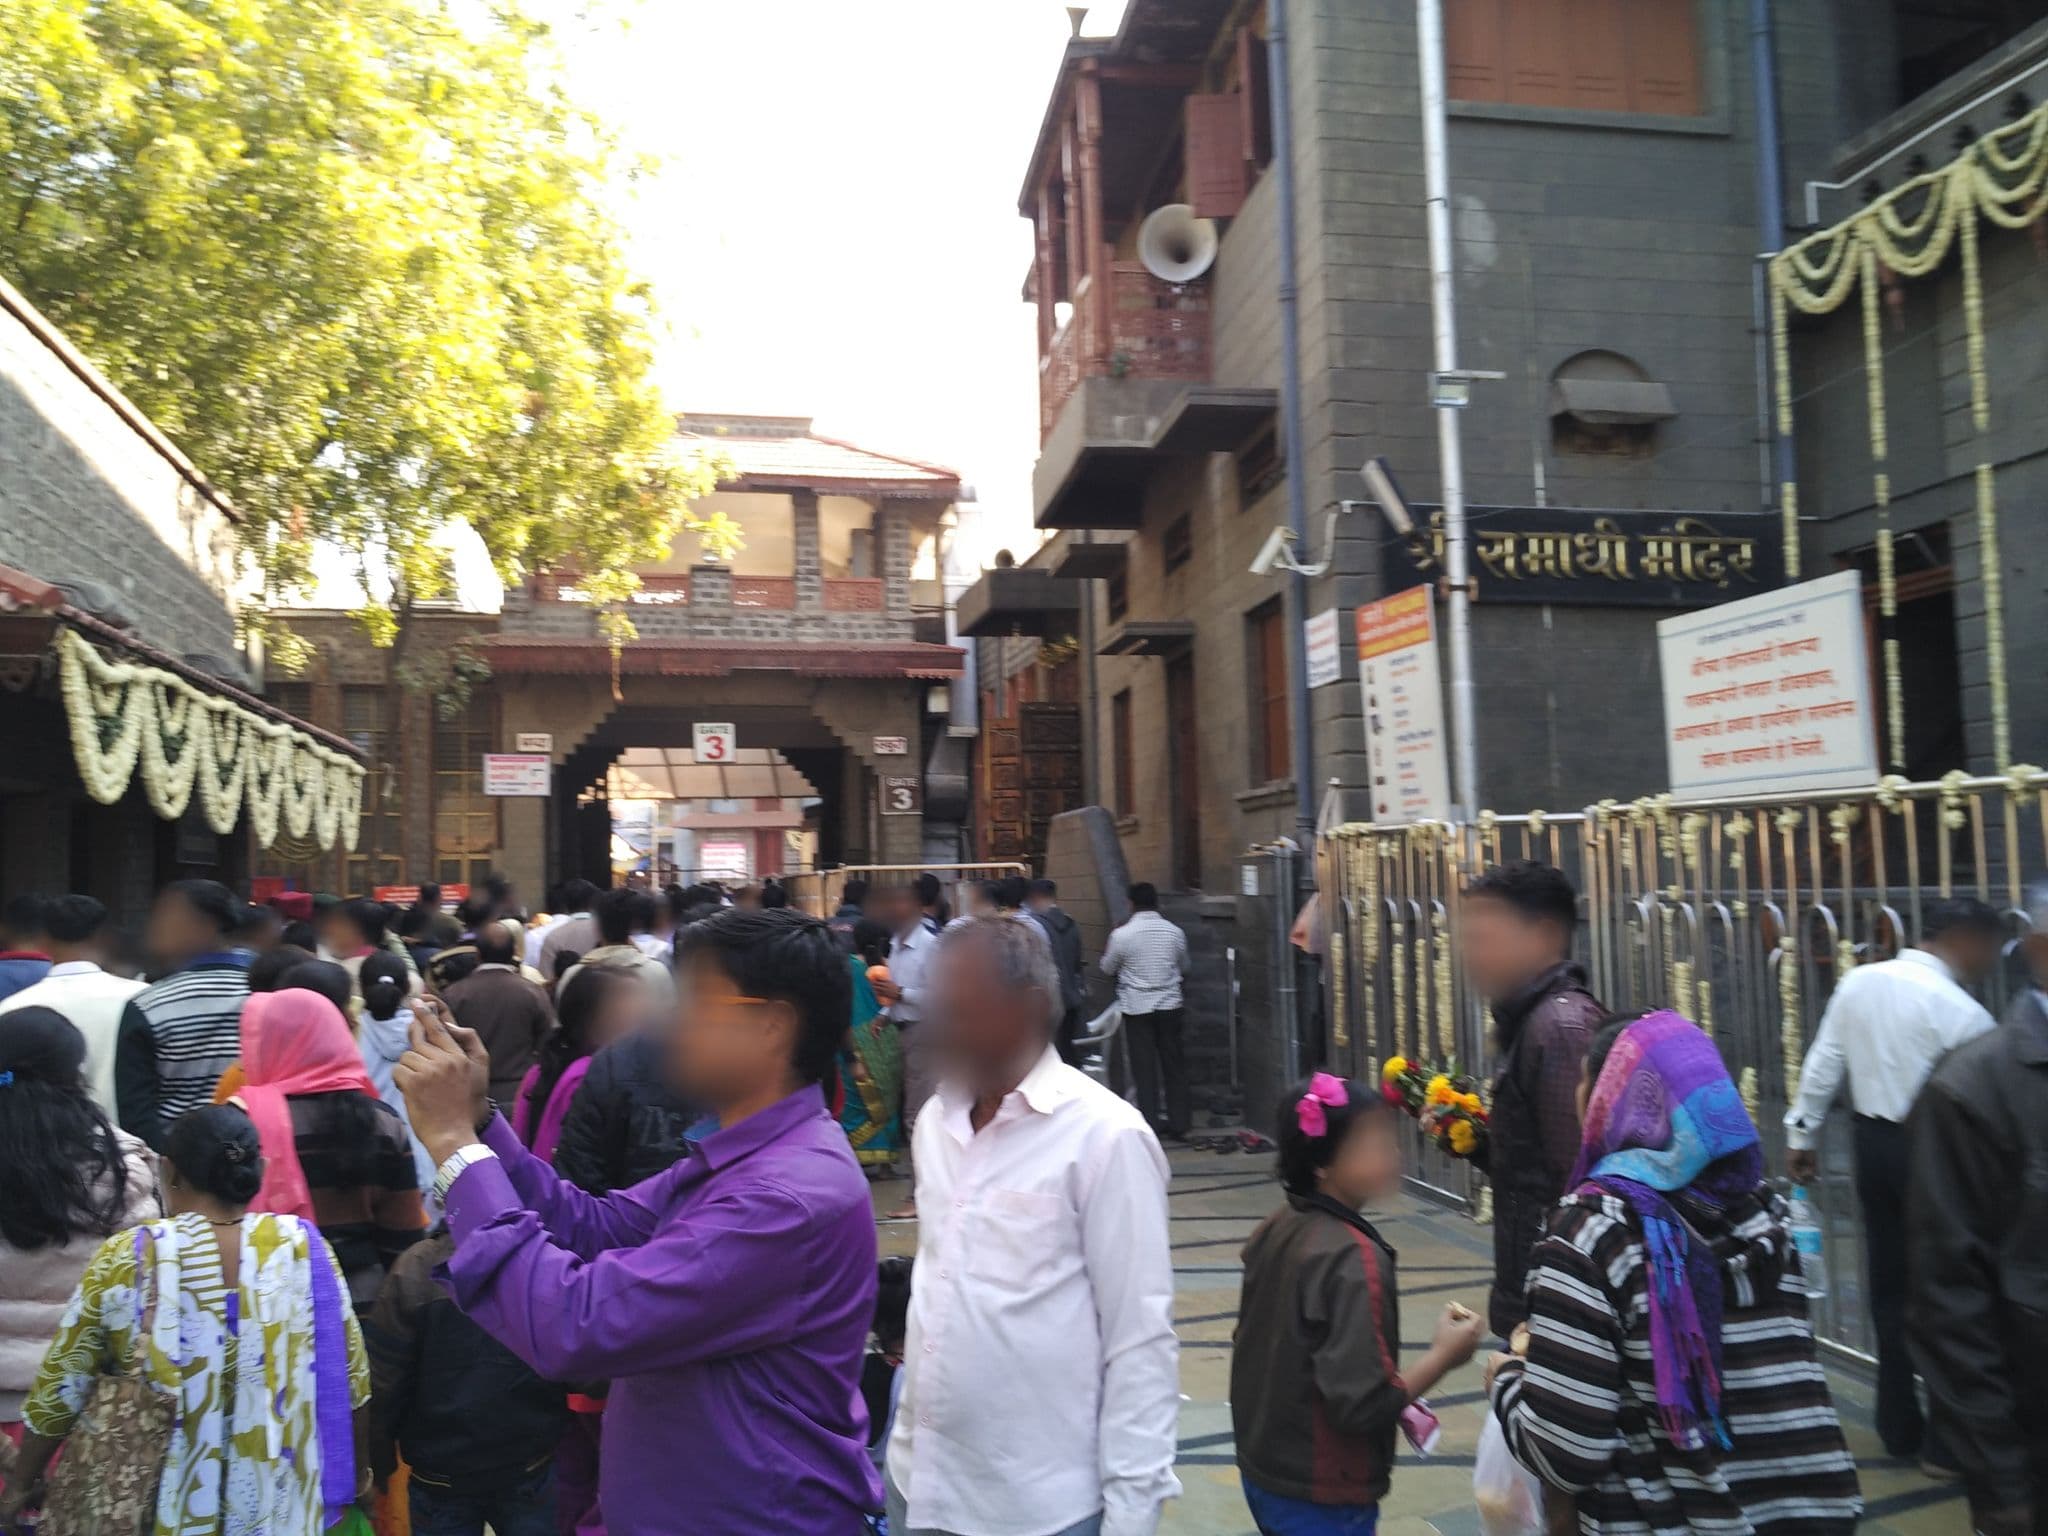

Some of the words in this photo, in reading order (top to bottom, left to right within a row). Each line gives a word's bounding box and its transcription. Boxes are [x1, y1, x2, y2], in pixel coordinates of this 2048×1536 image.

[700, 725, 729, 735] GATE
[704, 735, 725, 760] 3
[887, 777, 919, 787] GATE
[891, 788, 913, 810] 3
